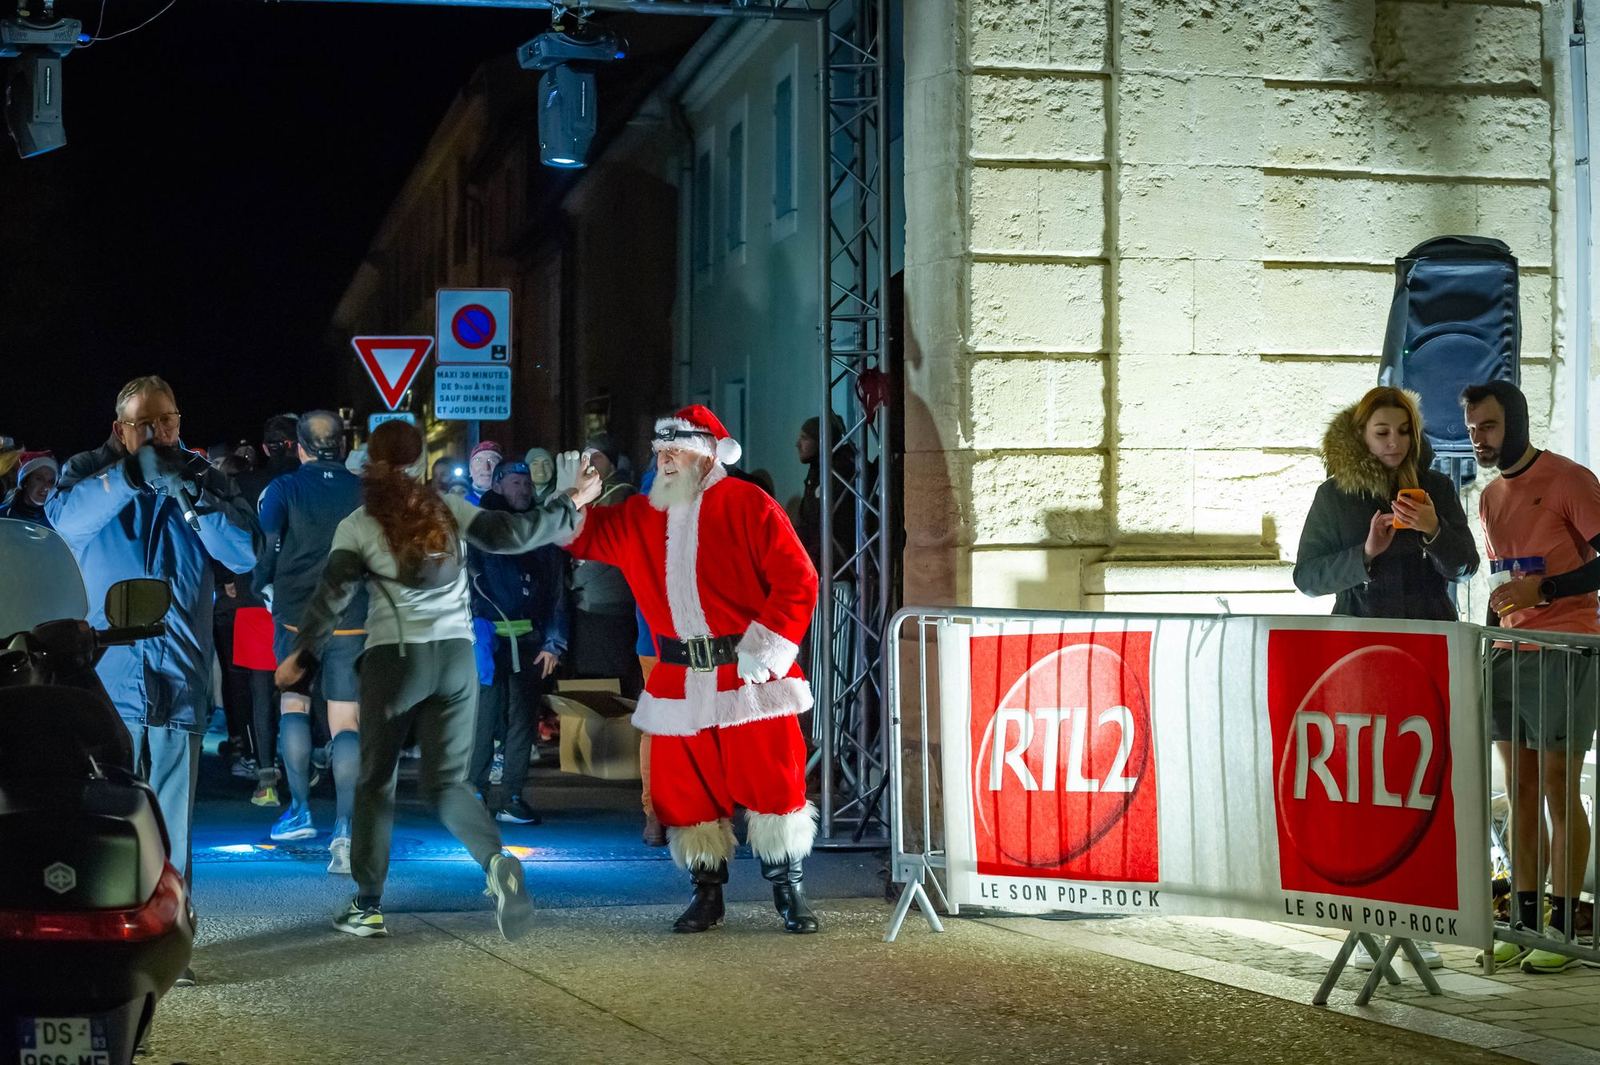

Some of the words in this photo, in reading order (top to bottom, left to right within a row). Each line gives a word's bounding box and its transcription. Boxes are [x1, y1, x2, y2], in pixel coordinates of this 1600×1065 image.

[437, 371, 458, 379] MAXI
[460, 371, 471, 379] 30
[472, 371, 509, 379] MINUTES
[441, 383, 452, 391] DE
[463, 395, 506, 403] DIMANCHE
[437, 406, 447, 414] ET
[449, 406, 477, 414] JOURS
[478, 404, 509, 414] FÉRIÉS
[988, 705, 1139, 793] RTL2
[1293, 710, 1436, 812] RTL2
[980, 882, 999, 899] LE
[1009, 884, 1047, 901] SON
[1058, 886, 1160, 908] POP-ROCK
[1284, 898, 1305, 916] LE
[1315, 901, 1353, 922] SON
[1363, 907, 1458, 937] POP-ROCK
